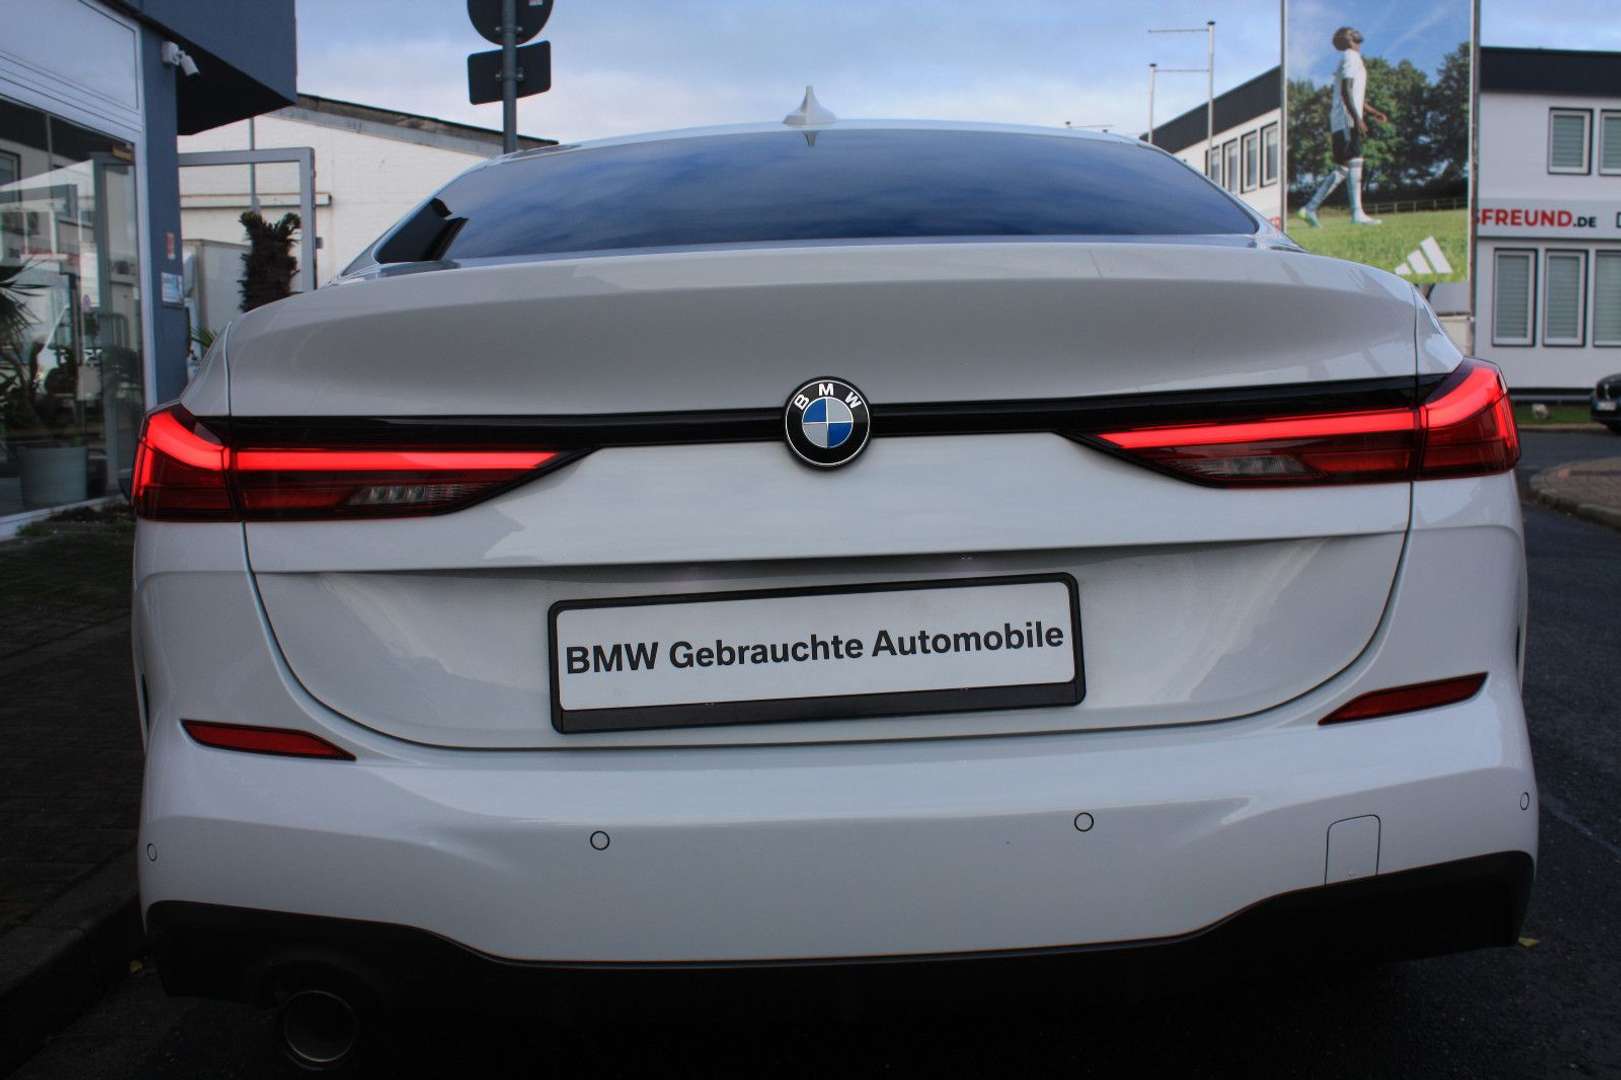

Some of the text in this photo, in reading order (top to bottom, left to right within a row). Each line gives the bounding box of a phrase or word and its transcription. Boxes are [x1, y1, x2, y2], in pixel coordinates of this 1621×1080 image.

[794, 383, 862, 411] BMW
[566, 621, 1065, 674] BMW Gebrauchte Automobile
